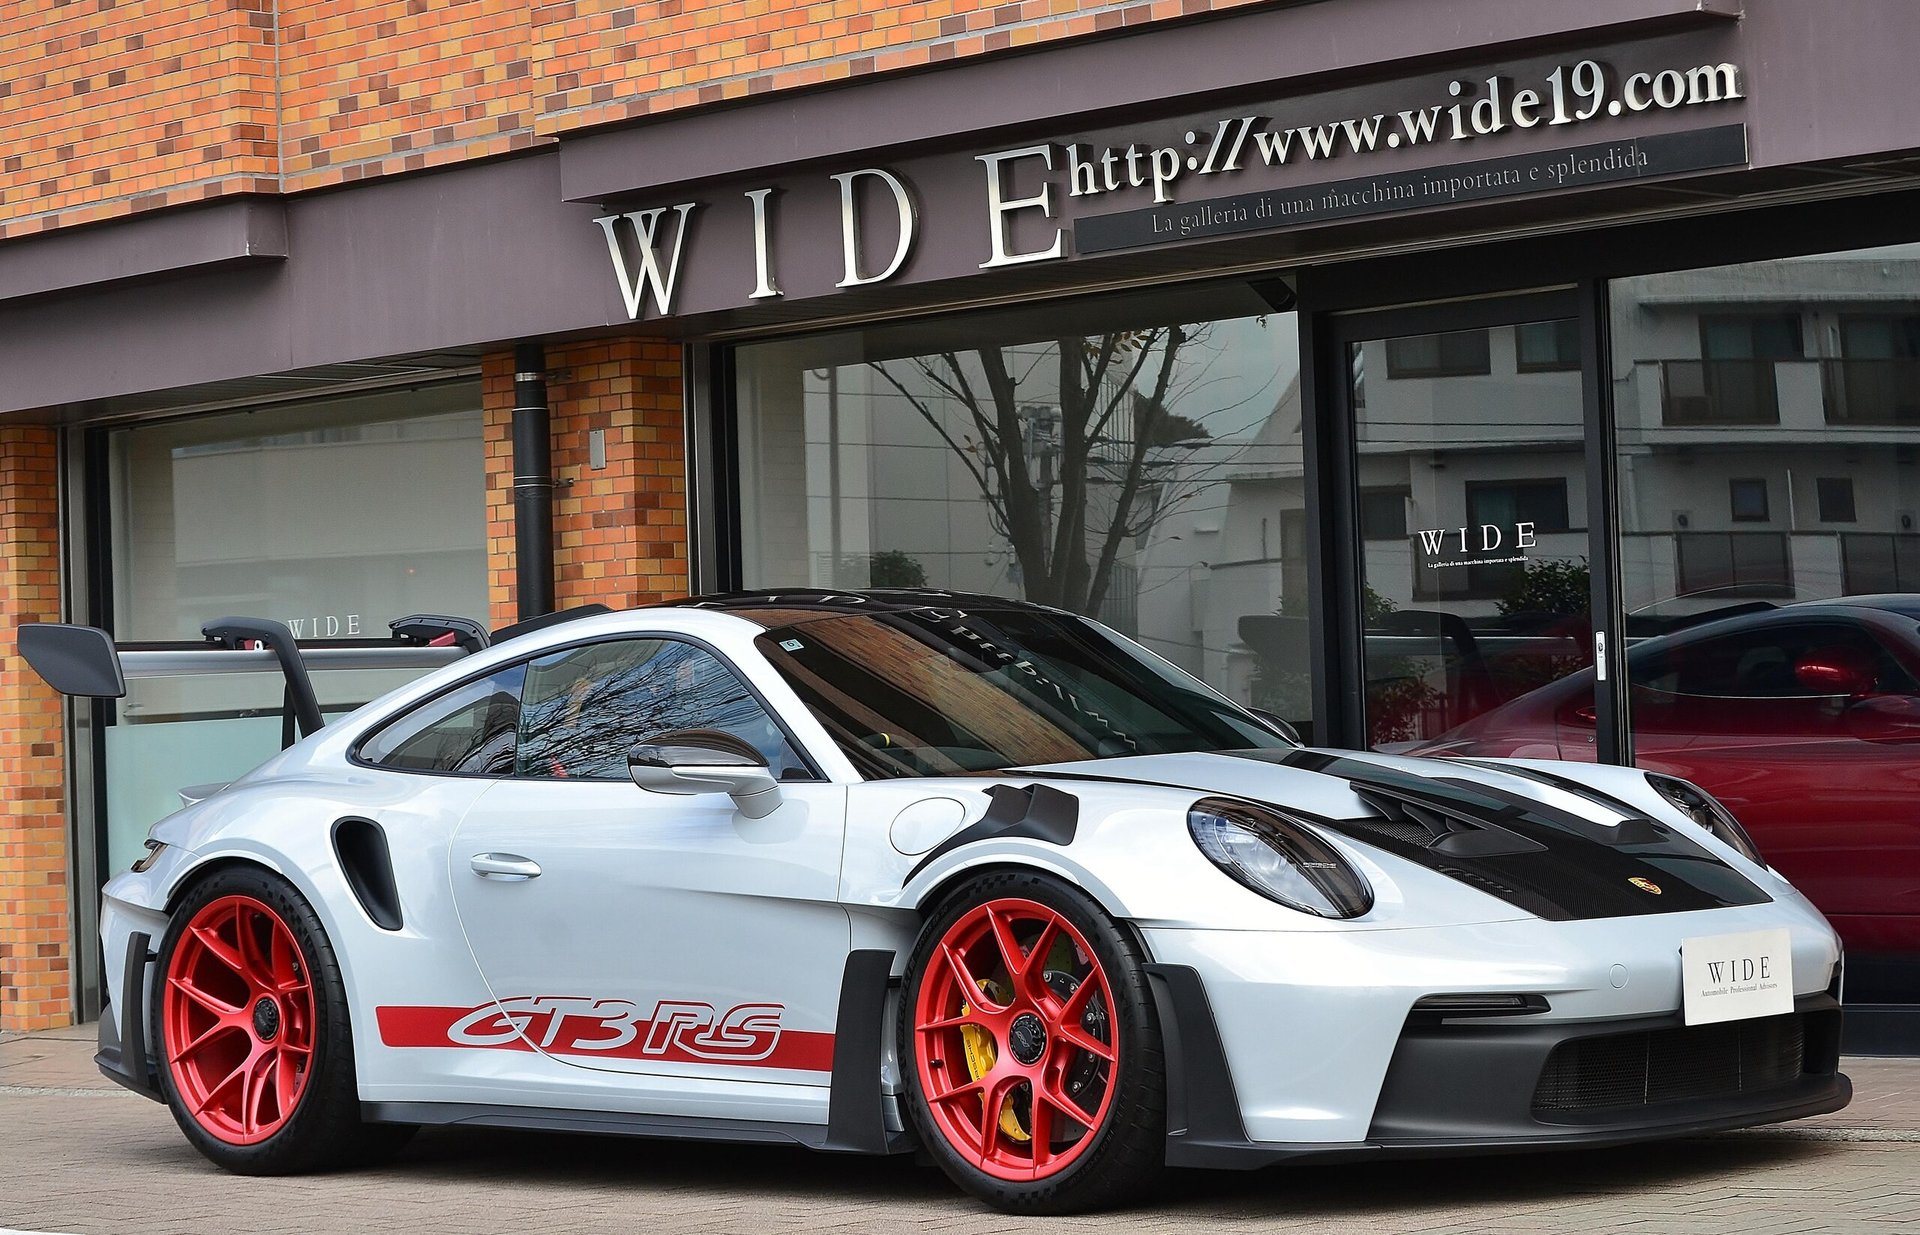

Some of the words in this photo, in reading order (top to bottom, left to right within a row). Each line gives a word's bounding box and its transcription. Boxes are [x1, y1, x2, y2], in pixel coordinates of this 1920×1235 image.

[1066, 60, 1746, 203] http://www.wide19.com
[1153, 214, 1173, 234] La
[1180, 202, 1248, 236] galleria
[1255, 197, 1273, 219] di
[1280, 197, 1314, 216] una
[1423, 165, 1520, 199] importata
[1529, 165, 1540, 181] e
[1547, 145, 1649, 183] splendida
[593, 143, 1068, 320] WIDE
[1418, 521, 1536, 556] WIDE
[288, 614, 360, 639] WIDE
[1707, 956, 1770, 984] WIDE
